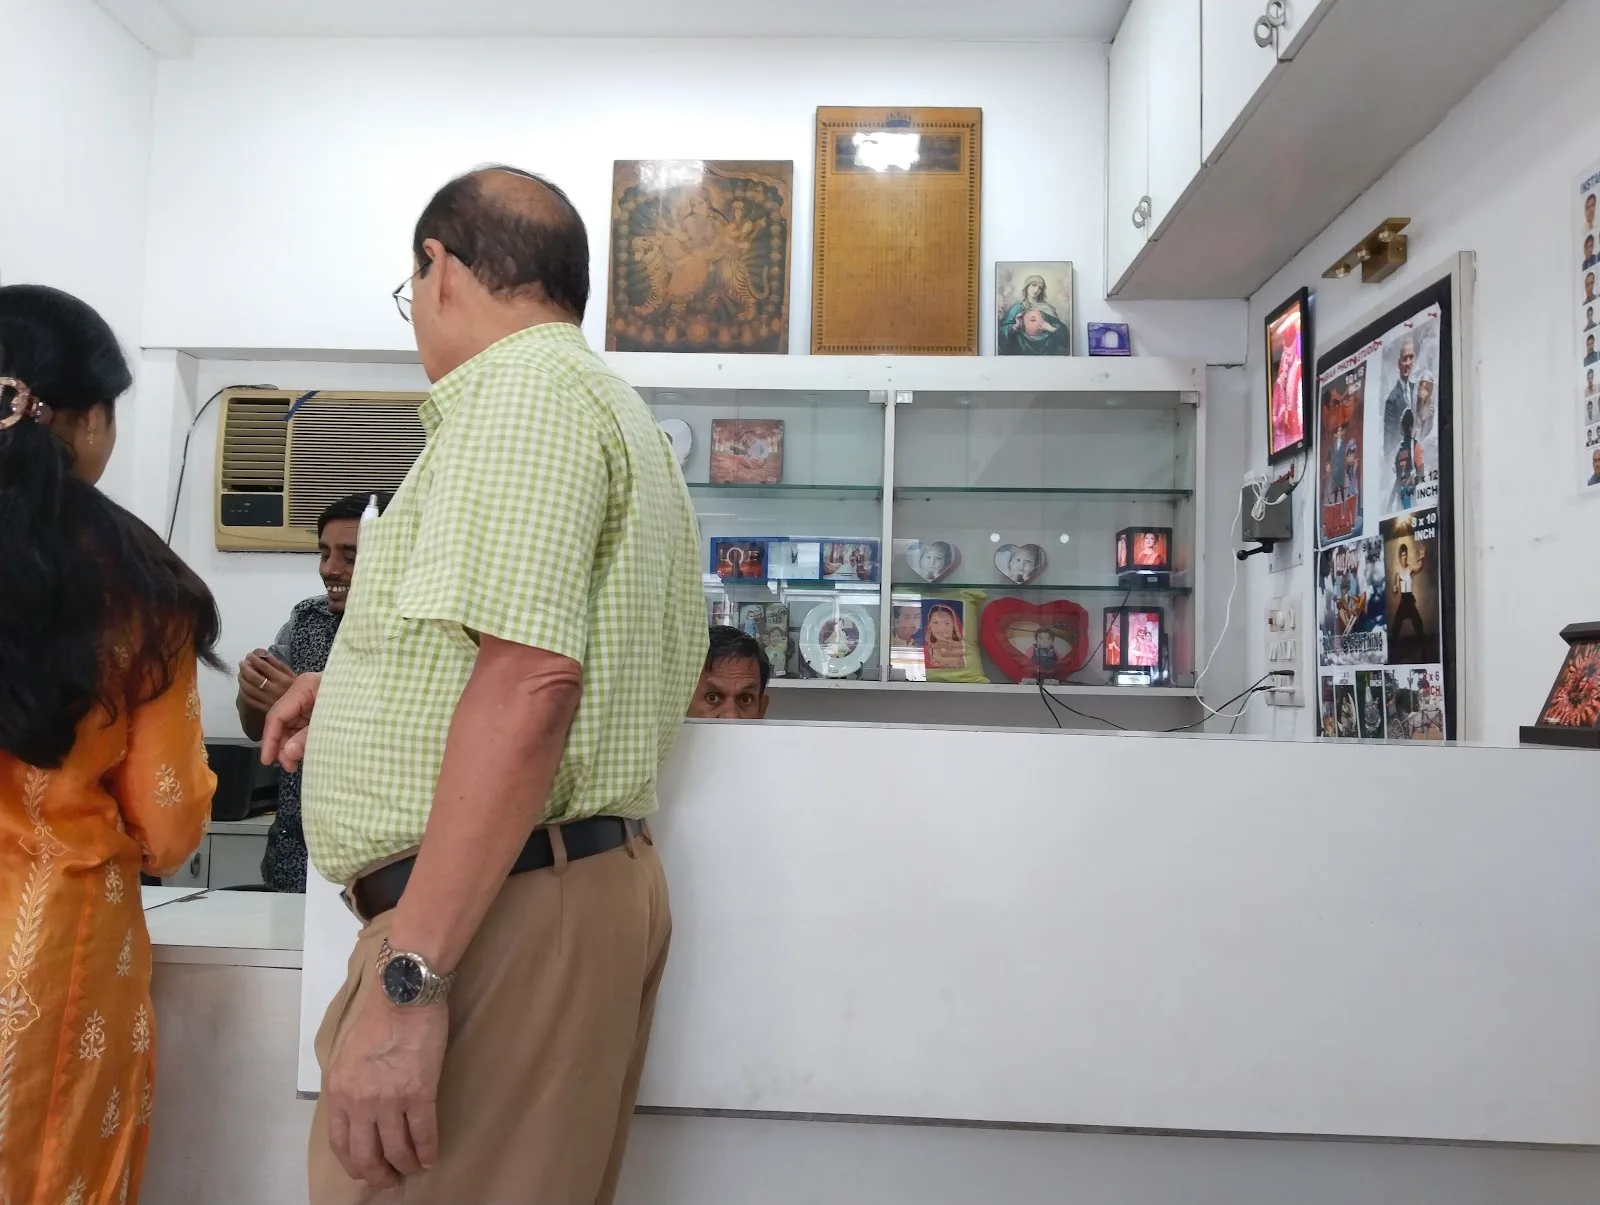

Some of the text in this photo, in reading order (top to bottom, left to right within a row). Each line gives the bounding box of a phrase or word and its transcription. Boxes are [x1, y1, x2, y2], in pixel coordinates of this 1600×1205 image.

[1429, 470, 1438, 481] 12
[1417, 485, 1438, 499] INCH
[1411, 517, 1417, 528] 8
[1426, 513, 1436, 525] 10
[1414, 528, 1435, 541] INCH
